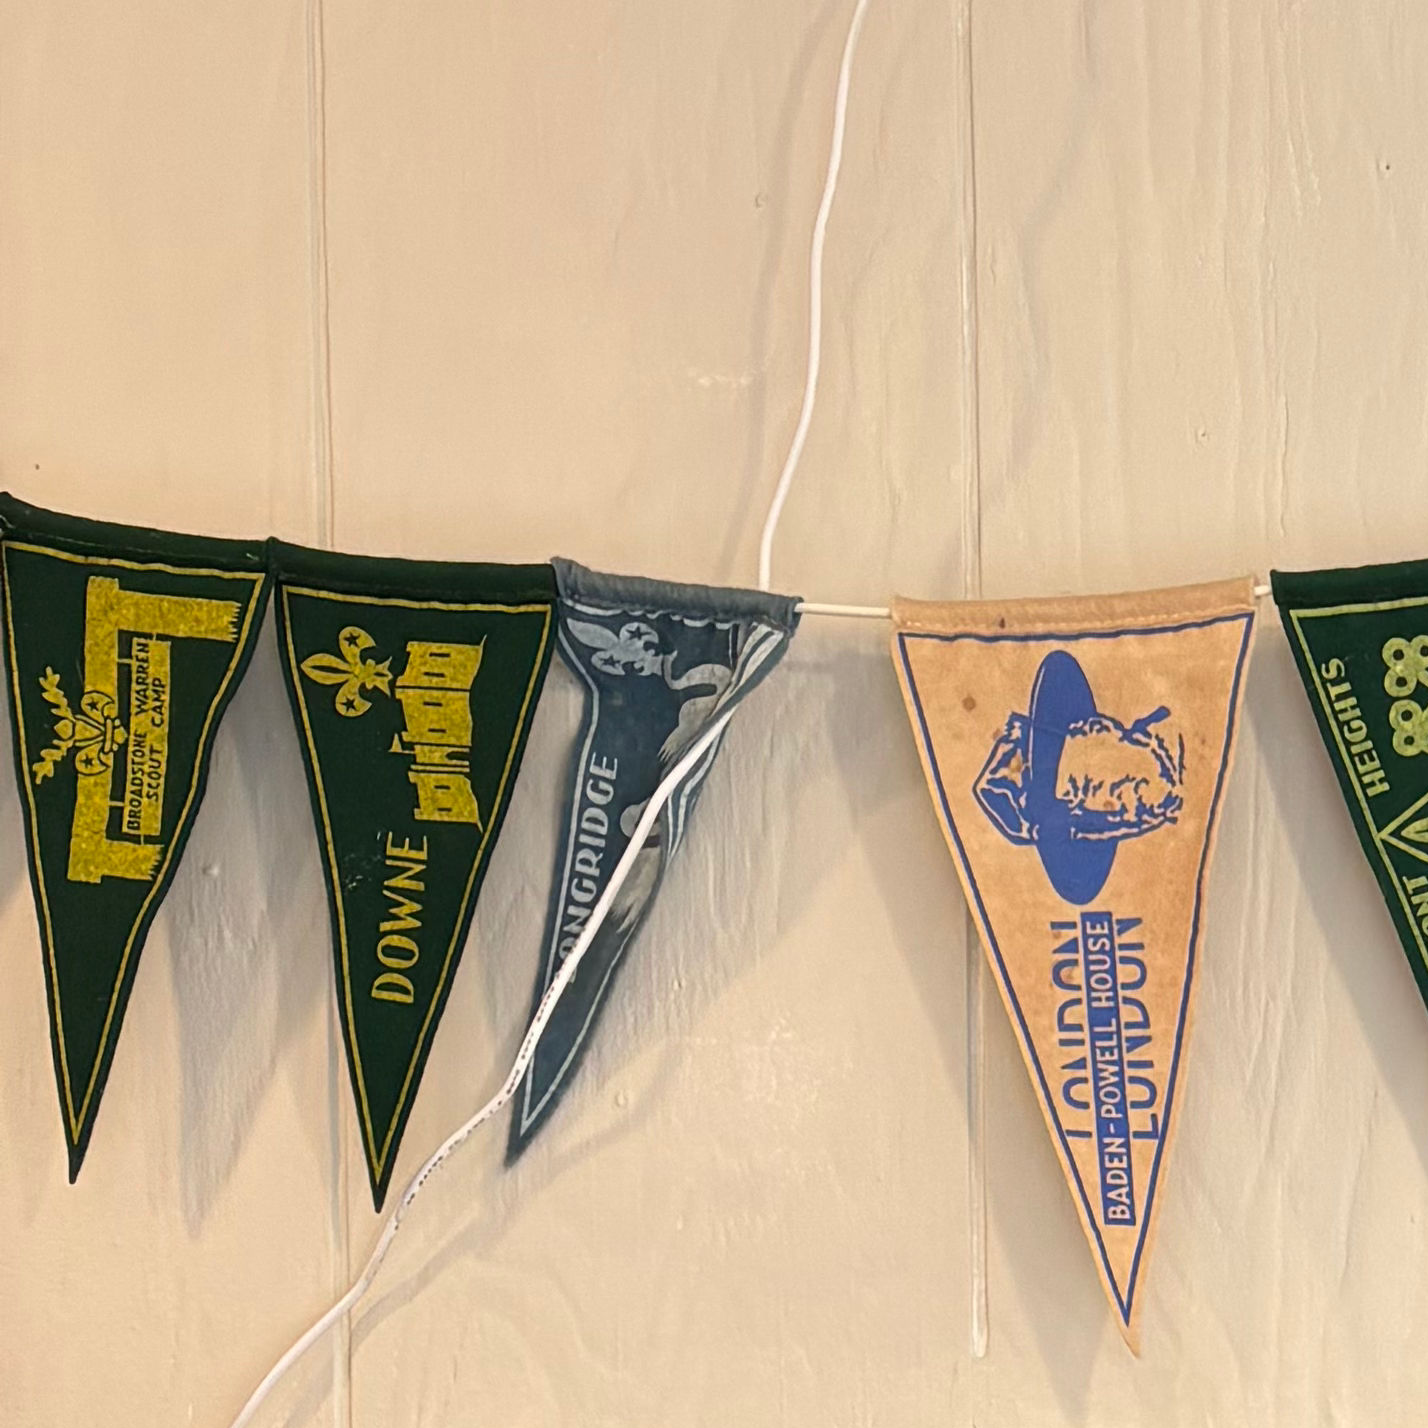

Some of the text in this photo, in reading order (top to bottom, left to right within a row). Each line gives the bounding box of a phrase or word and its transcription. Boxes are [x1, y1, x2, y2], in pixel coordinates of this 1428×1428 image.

[127, 640, 149, 831] BROADSTONE WARREN
[147, 677, 167, 803] SCOUT CAMP
[1321, 657, 1390, 798] HEIGHTS
[371, 831, 428, 1004] DOWNE
[558, 752, 618, 984] ONGRIDGE
[1086, 920, 1114, 1008] HOUSE
